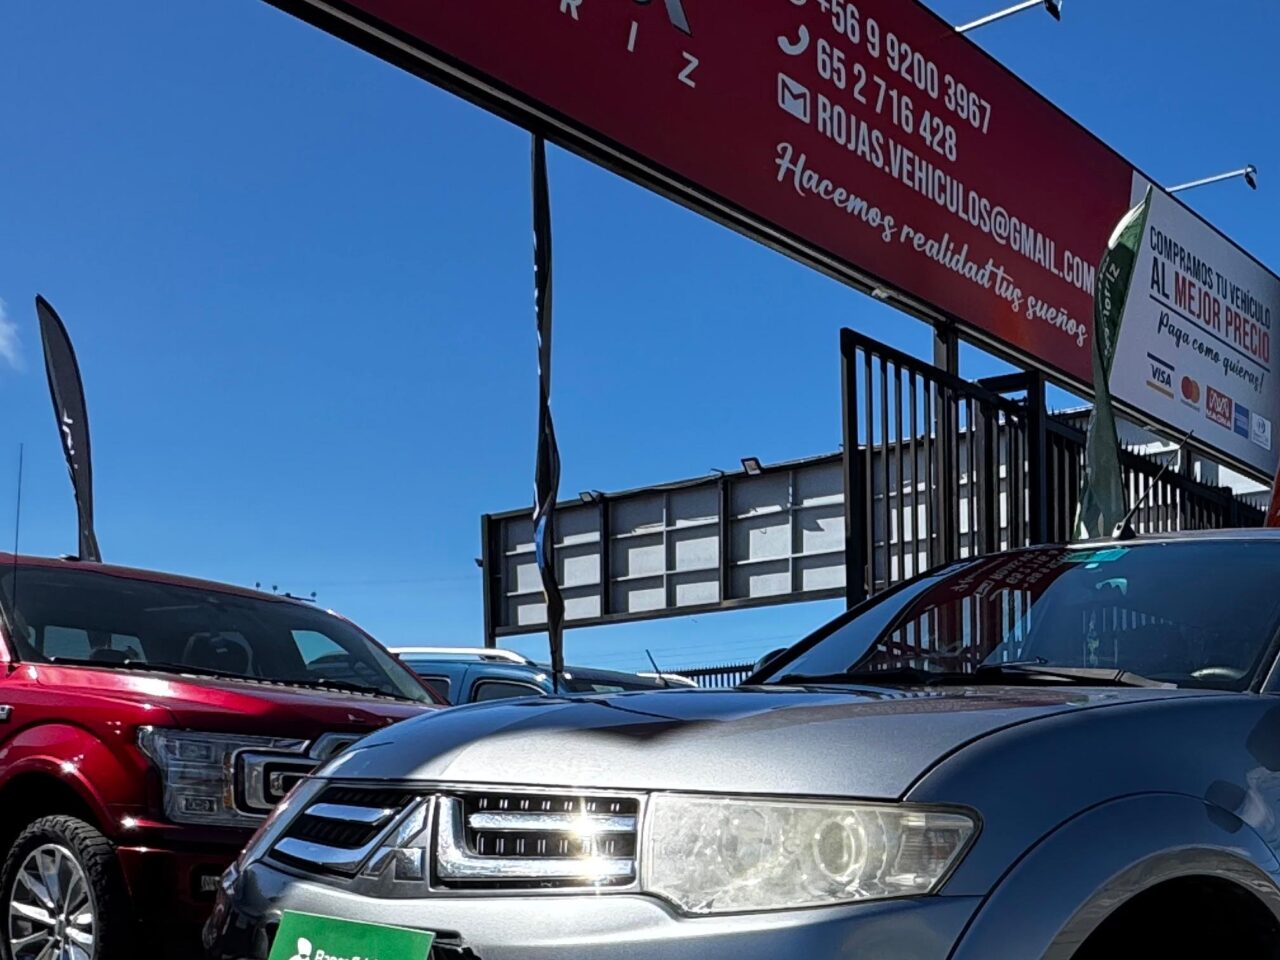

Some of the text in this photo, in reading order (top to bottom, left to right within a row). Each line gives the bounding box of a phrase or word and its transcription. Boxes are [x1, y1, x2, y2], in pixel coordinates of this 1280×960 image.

[816, 38, 957, 162] 65 2 716 428
[866, 18, 880, 58] 9
[886, 32, 939, 99] 9200
[944, 74, 992, 134] 3967
[775, 142, 1088, 347] Hacemos realidad tus sueños
[817, 93, 1095, 296] ROJAS.VEHICULOS@GMAIL.COM
[1150, 225, 1214, 290] COMPRAMOS
[1215, 272, 1228, 300] TU
[1229, 281, 1271, 330] VEHÍCULO
[1150, 256, 1170, 300] AL
[1174, 271, 1221, 333] MEJOR
[1225, 305, 1270, 363] PRECIO
[1150, 364, 1172, 388] VISA
[1157, 310, 1265, 394] Paga como quieras!
